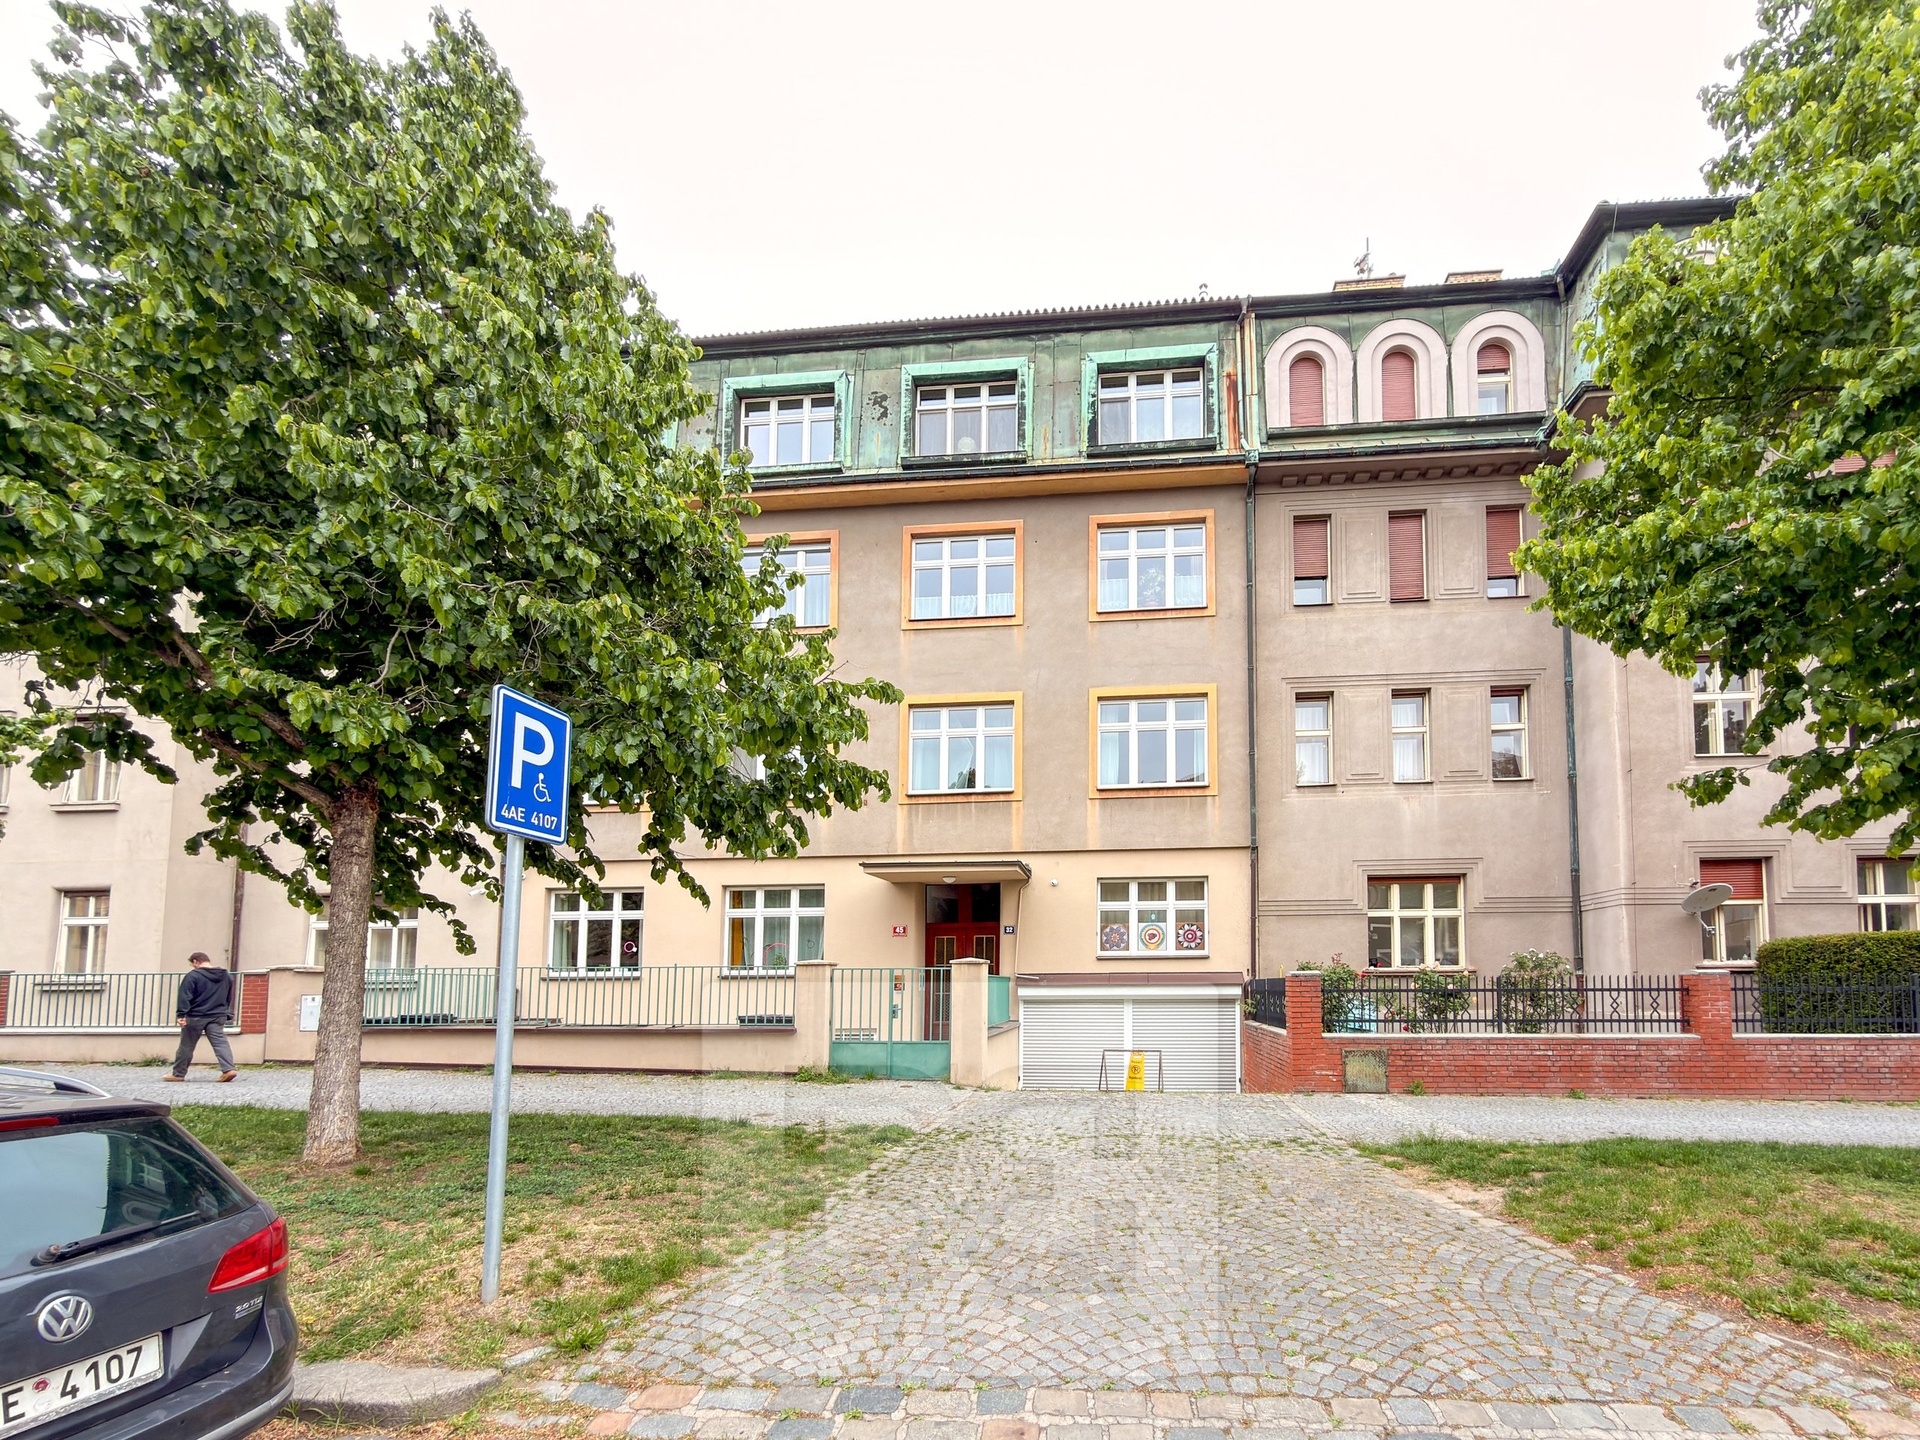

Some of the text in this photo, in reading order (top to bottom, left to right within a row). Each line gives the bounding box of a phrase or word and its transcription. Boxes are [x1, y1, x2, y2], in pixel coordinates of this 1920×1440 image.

[511, 711, 555, 789] P
[501, 803, 558, 830] 4AE 4107
[2, 1345, 143, 1425] E 4107
